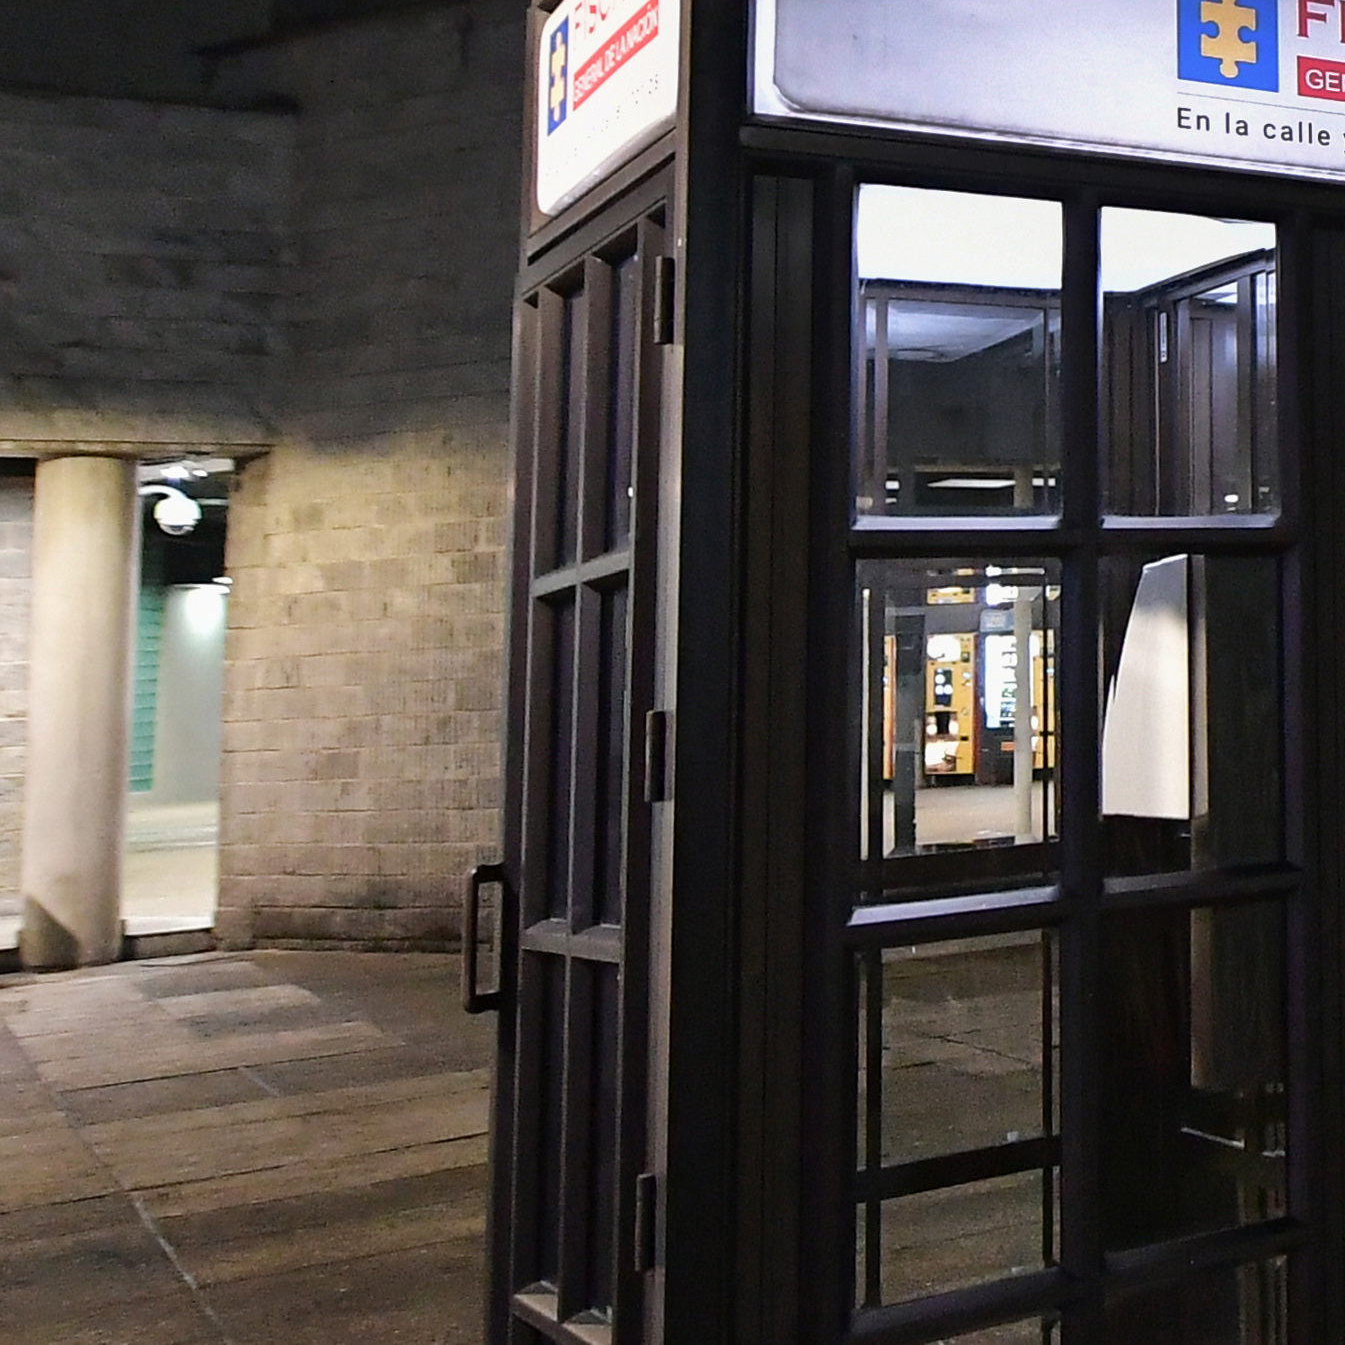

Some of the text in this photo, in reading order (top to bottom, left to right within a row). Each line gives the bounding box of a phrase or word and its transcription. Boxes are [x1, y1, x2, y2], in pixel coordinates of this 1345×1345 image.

[1177, 107, 1210, 132] En
[1225, 112, 1249, 136] la
[1263, 120, 1331, 146] calle
